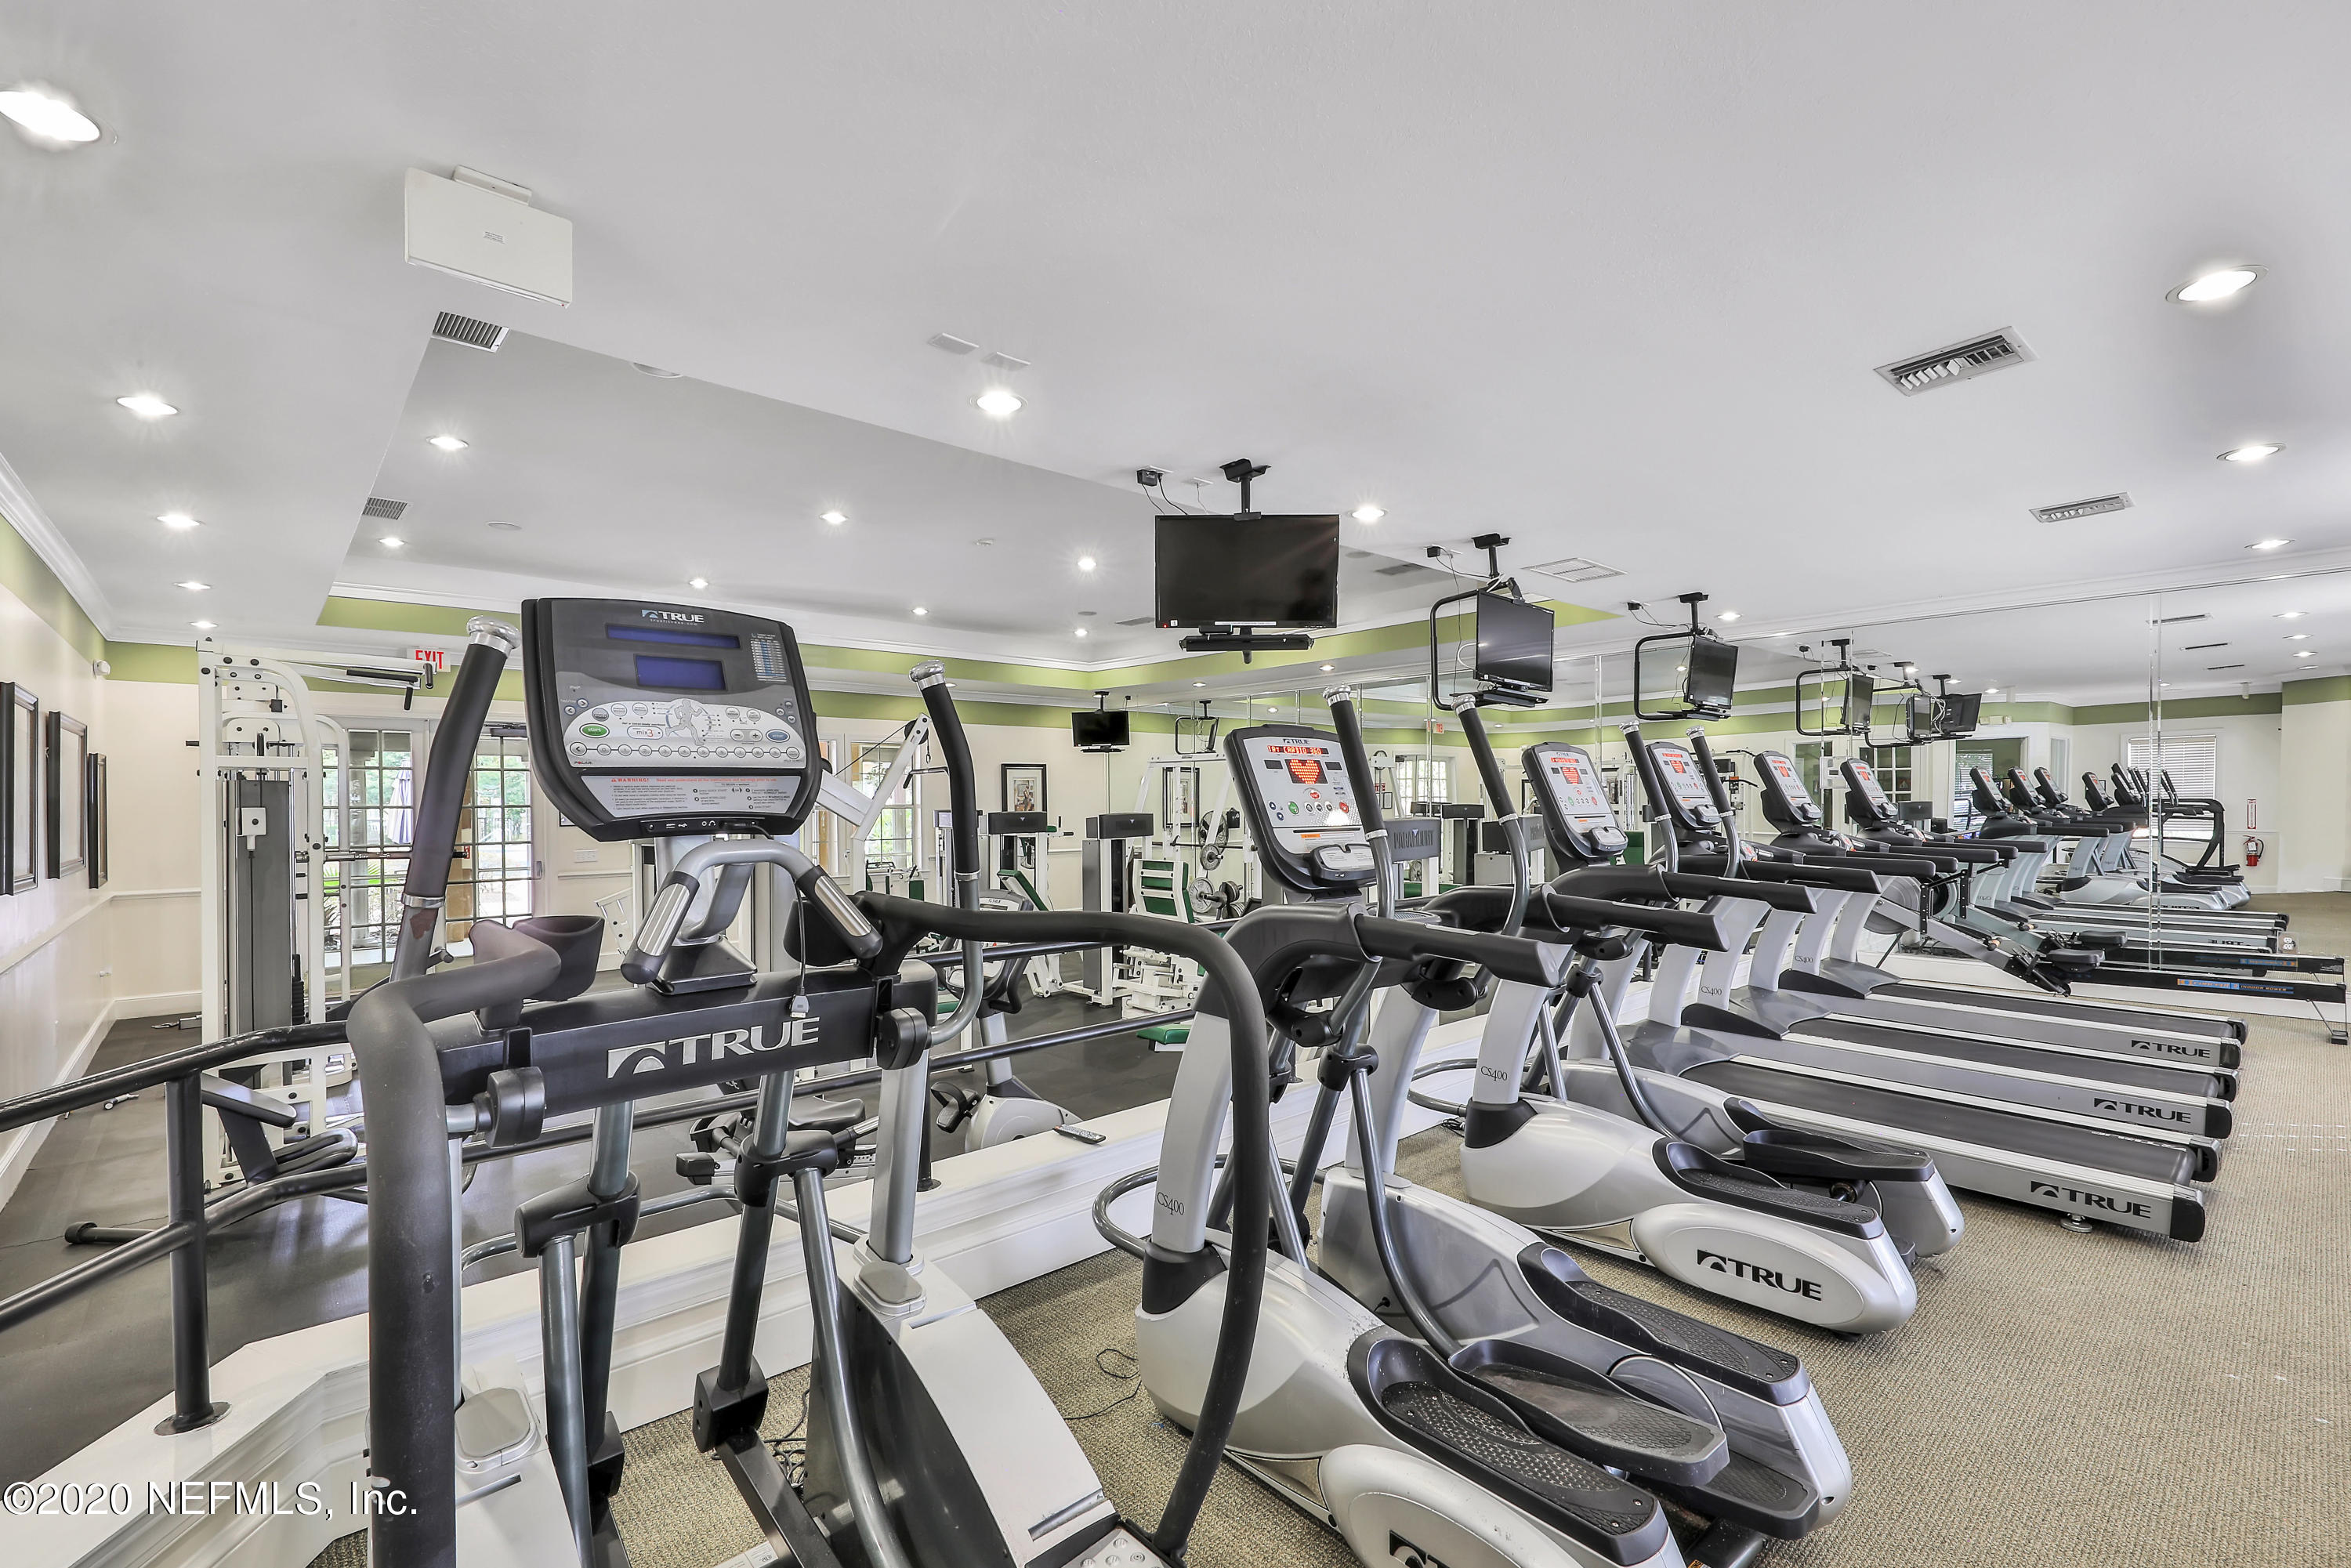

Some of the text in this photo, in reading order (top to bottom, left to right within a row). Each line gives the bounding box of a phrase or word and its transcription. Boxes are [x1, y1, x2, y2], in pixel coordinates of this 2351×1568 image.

[658, 610, 705, 623] TRUE
[415, 650, 444, 668] EXIT
[1795, 955, 1813, 964] CS400
[1701, 986, 1722, 996] CS400
[668, 1016, 820, 1066] TRUE
[2152, 1042, 2211, 1059] TRUE
[1480, 1066, 1508, 1081] CS400
[2119, 1102, 2192, 1124] TRUE
[1157, 1191, 1185, 1215] CS400
[2061, 1187, 2151, 1219] TRUE
[1727, 1258, 1822, 1302] TRUE
